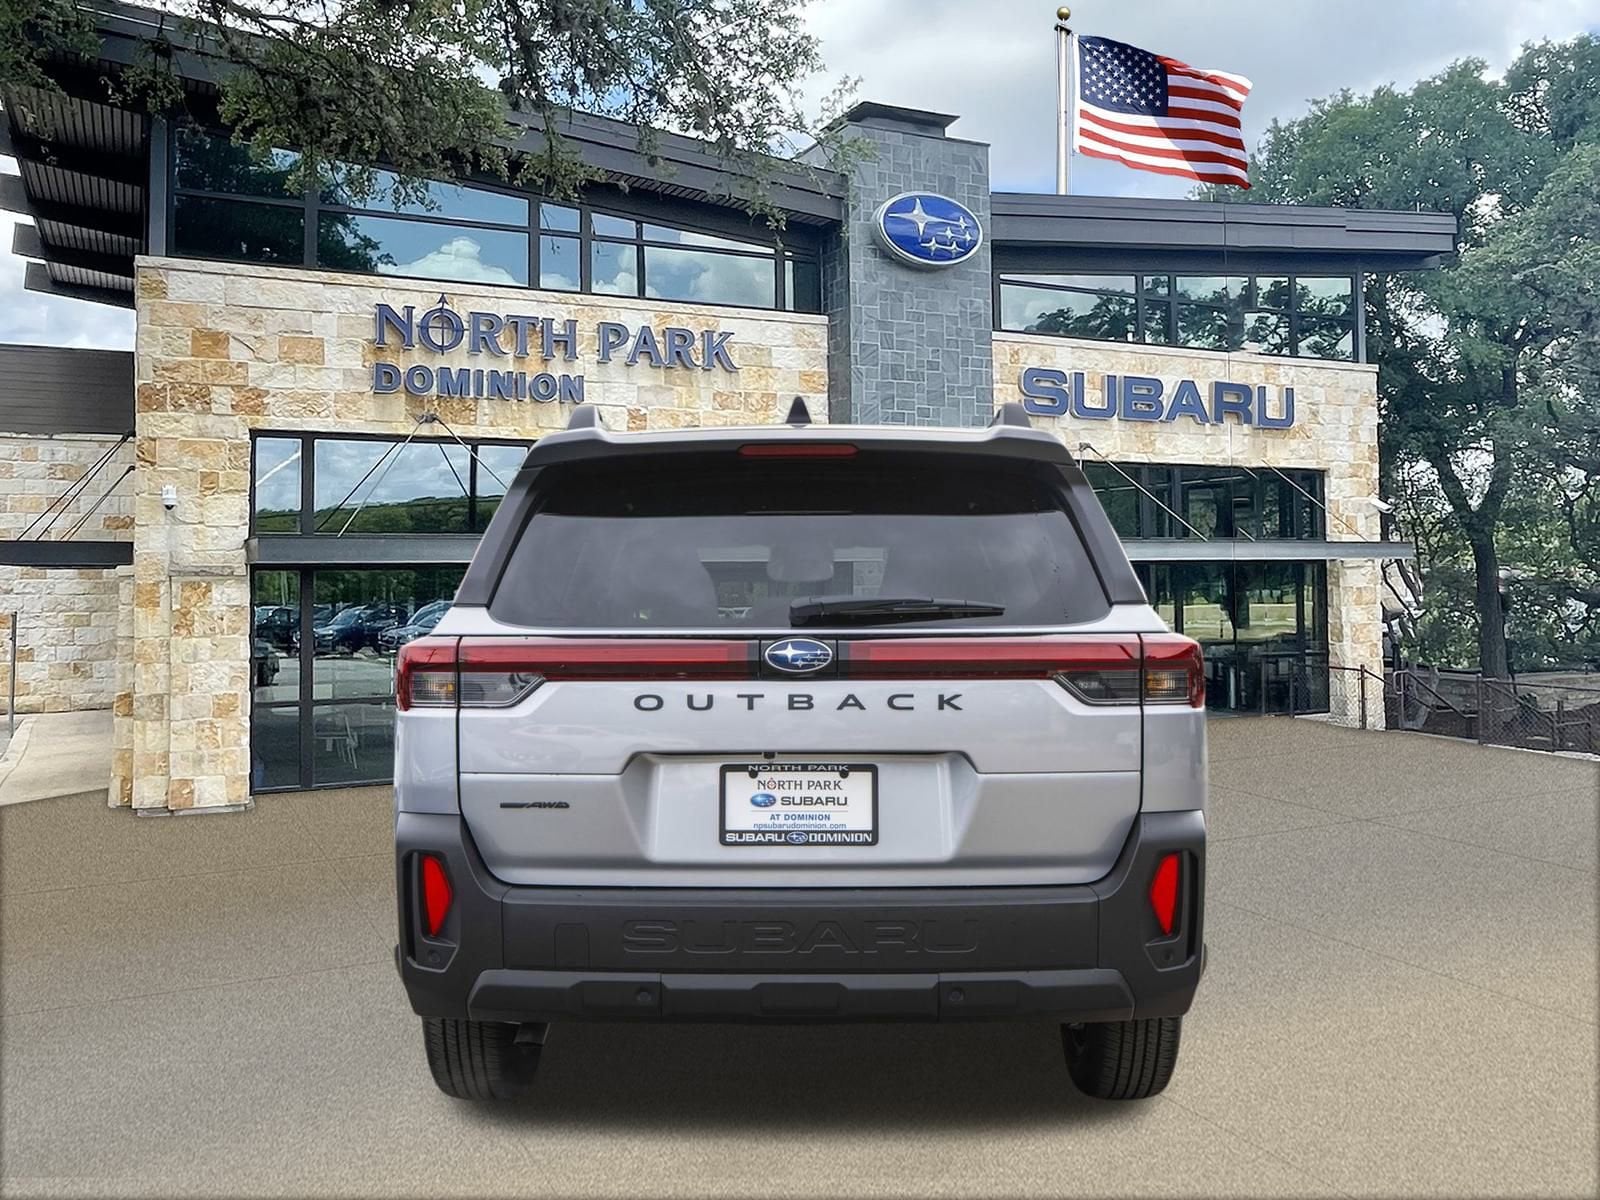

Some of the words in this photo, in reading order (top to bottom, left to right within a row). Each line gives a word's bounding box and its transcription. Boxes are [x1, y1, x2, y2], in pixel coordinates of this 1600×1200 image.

[374, 293, 580, 361] NORTH
[597, 321, 742, 373] PARK
[373, 362, 585, 404] DOMINION
[1019, 367, 1295, 430] SUBARU
[633, 693, 964, 712] OUTBACK
[757, 778, 803, 791] NORTH
[807, 780, 843, 791] PARK
[780, 796, 848, 806] SUBARU
[769, 813, 780, 821] AT
[784, 813, 831, 821] DOMINION
[753, 822, 847, 831] npsubarudominion.com
[725, 833, 785, 842] SUBARU
[808, 833, 872, 842] DOMINION
[623, 920, 978, 954] SUBARU
